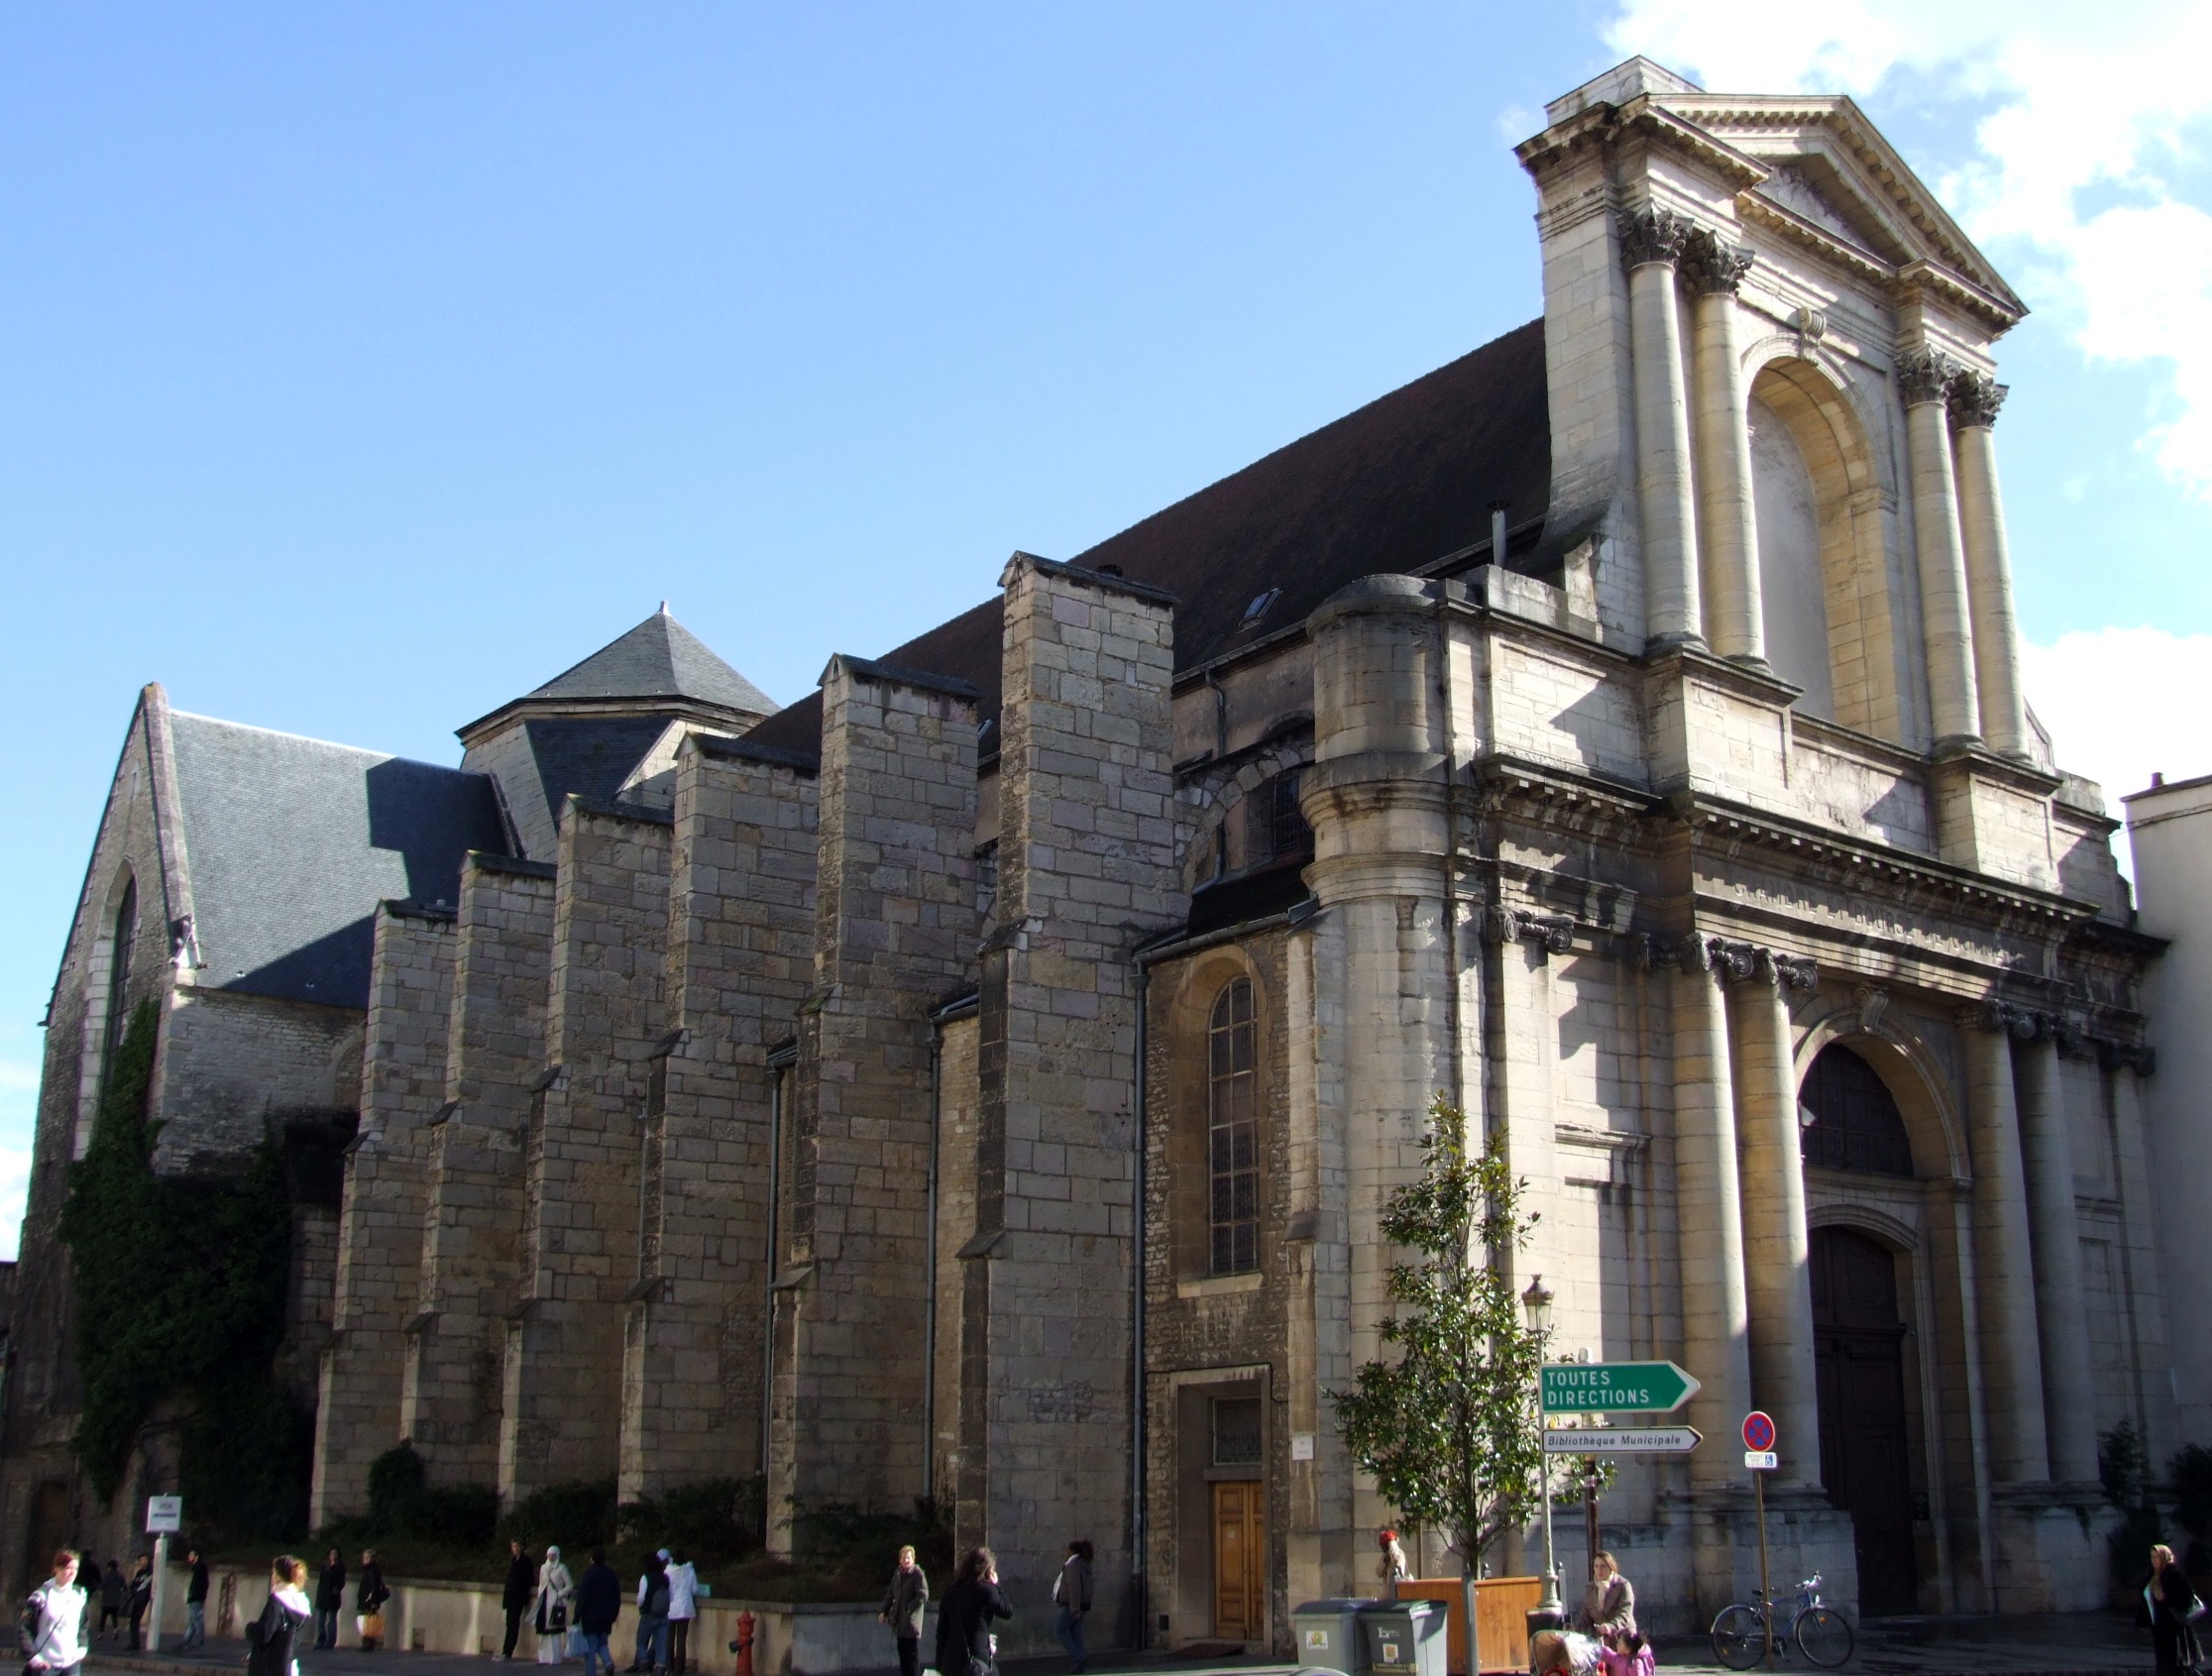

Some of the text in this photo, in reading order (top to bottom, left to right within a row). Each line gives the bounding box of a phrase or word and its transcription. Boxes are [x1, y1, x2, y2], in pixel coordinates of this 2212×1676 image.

[1547, 1371, 1610, 1387] TOUTES
[1547, 1389, 1650, 1405] DIRECTIONS
[1548, 1434, 1681, 1447] Bibliothèque Municipale
